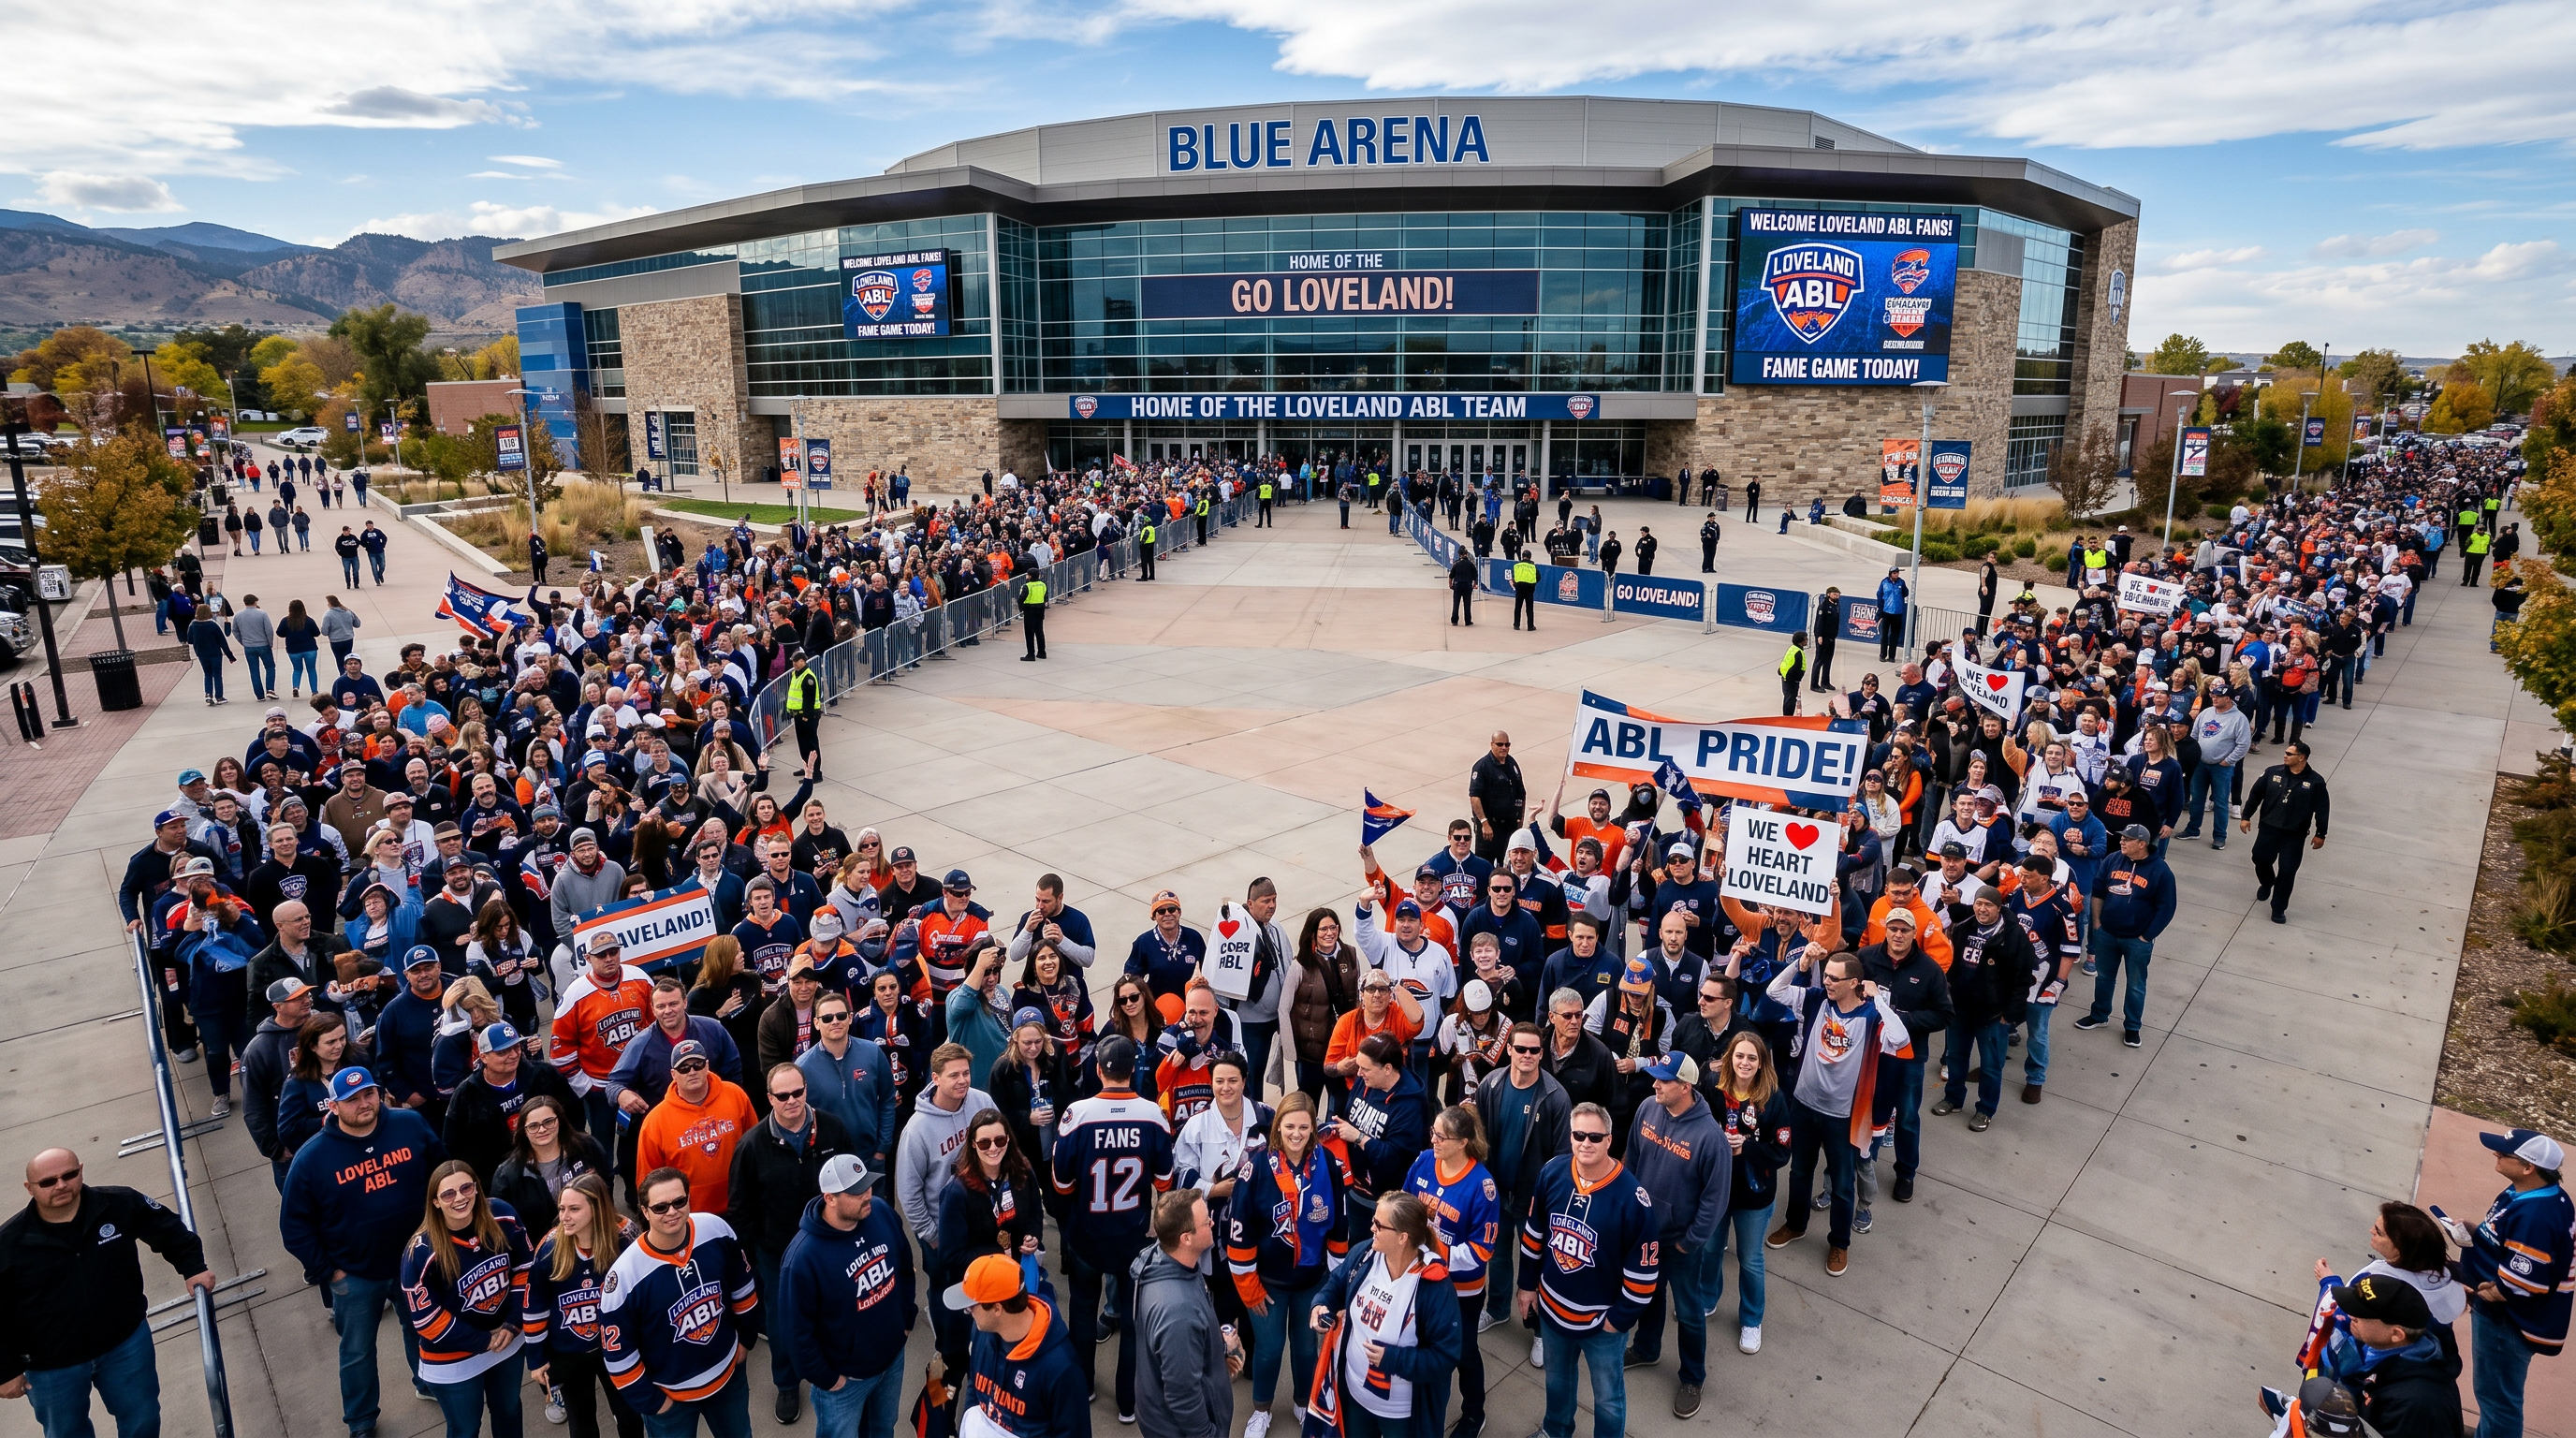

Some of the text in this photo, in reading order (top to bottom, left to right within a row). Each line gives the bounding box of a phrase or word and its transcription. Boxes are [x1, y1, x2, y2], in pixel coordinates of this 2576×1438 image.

[1168, 115, 1491, 172] BLUE ARENA
[1750, 213, 1953, 236] WELCOME LOVELAND ABL FANS!
[1290, 254, 1383, 269] HOME OF THE
[1773, 251, 1854, 277] LOVELAND
[862, 289, 891, 304] ABL
[1232, 276, 1454, 313] GO LOVELAND!
[1782, 280, 1843, 309] ABL
[857, 323, 935, 337] FAME GAME TODAY!
[1763, 358, 1920, 380] FAME GAME TODAY!
[1131, 396, 1526, 418] HOME OF THE LOVELAND ABL TEAM
[1617, 584, 1700, 608] GO LOVELAND!
[1966, 668, 1983, 683] WE
[1581, 717, 1857, 786] ABL PRIDE!
[1748, 818, 1779, 843] WE
[1747, 846, 1813, 874] HEART
[1728, 868, 1830, 904] LOVELAND
[1094, 1128, 1140, 1149] FANS
[336, 1147, 412, 1184] LOVELAND
[365, 1170, 397, 1193] ABL
[1090, 1156, 1144, 1212] 12
[1231, 1218, 1243, 1241] 12
[1551, 1232, 1590, 1263] ABL
[1640, 1241, 1659, 1266] 12
[466, 1271, 509, 1309] ABL
[856, 1259, 894, 1298] ABL
[407, 1287, 432, 1312] 12
[565, 1305, 601, 1325] AB
[678, 1300, 723, 1337] ABL
[600, 1325, 622, 1351] 12
